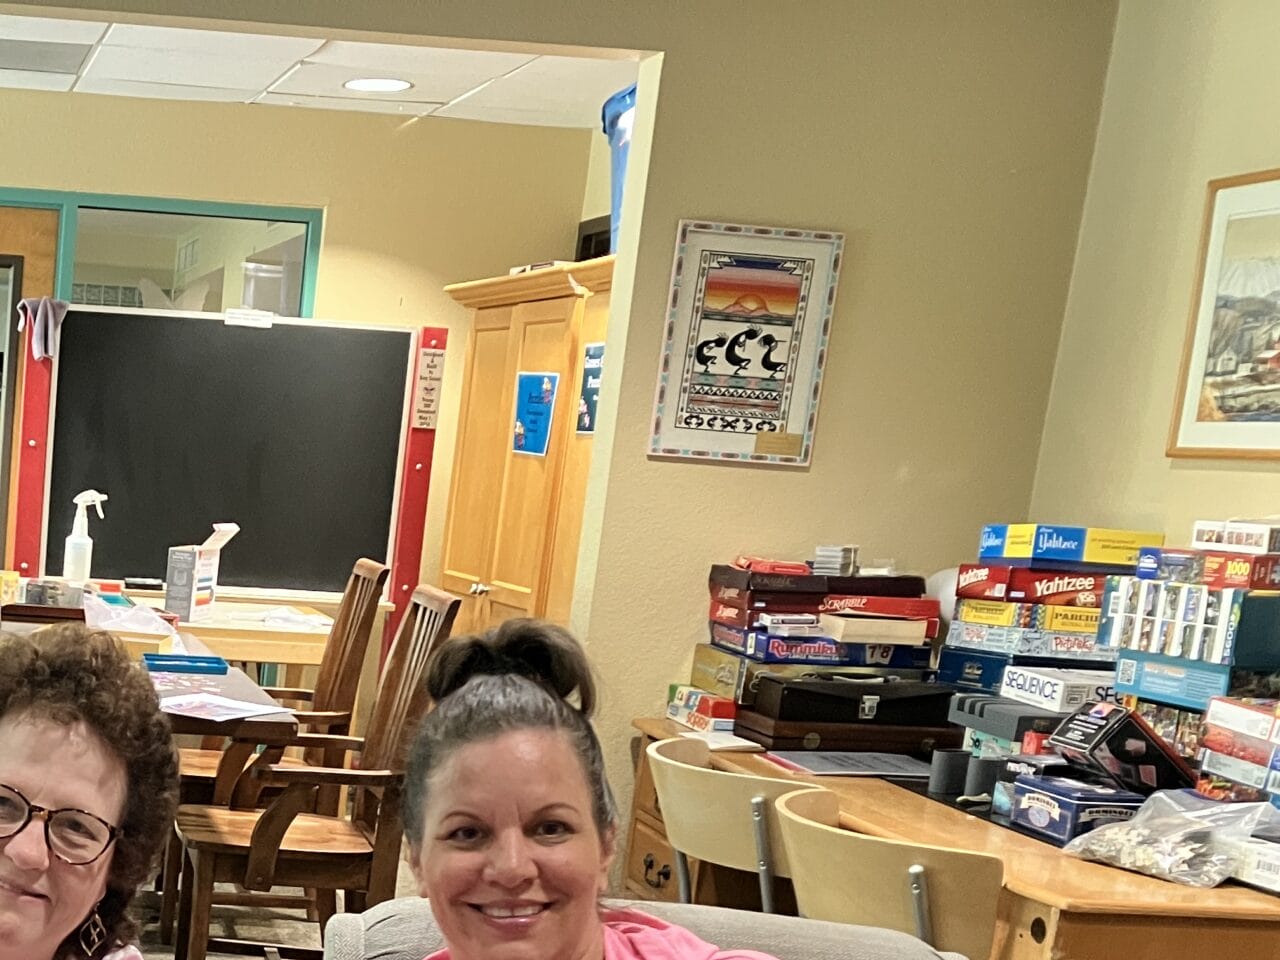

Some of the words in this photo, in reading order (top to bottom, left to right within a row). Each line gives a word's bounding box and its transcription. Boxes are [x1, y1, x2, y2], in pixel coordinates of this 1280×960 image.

[1036, 533, 1078, 553] Yahtzee
[1226, 560, 1251, 576] 1000
[1035, 576, 1095, 597] Yahtzee
[1005, 670, 1059, 700] SEQUENCE
